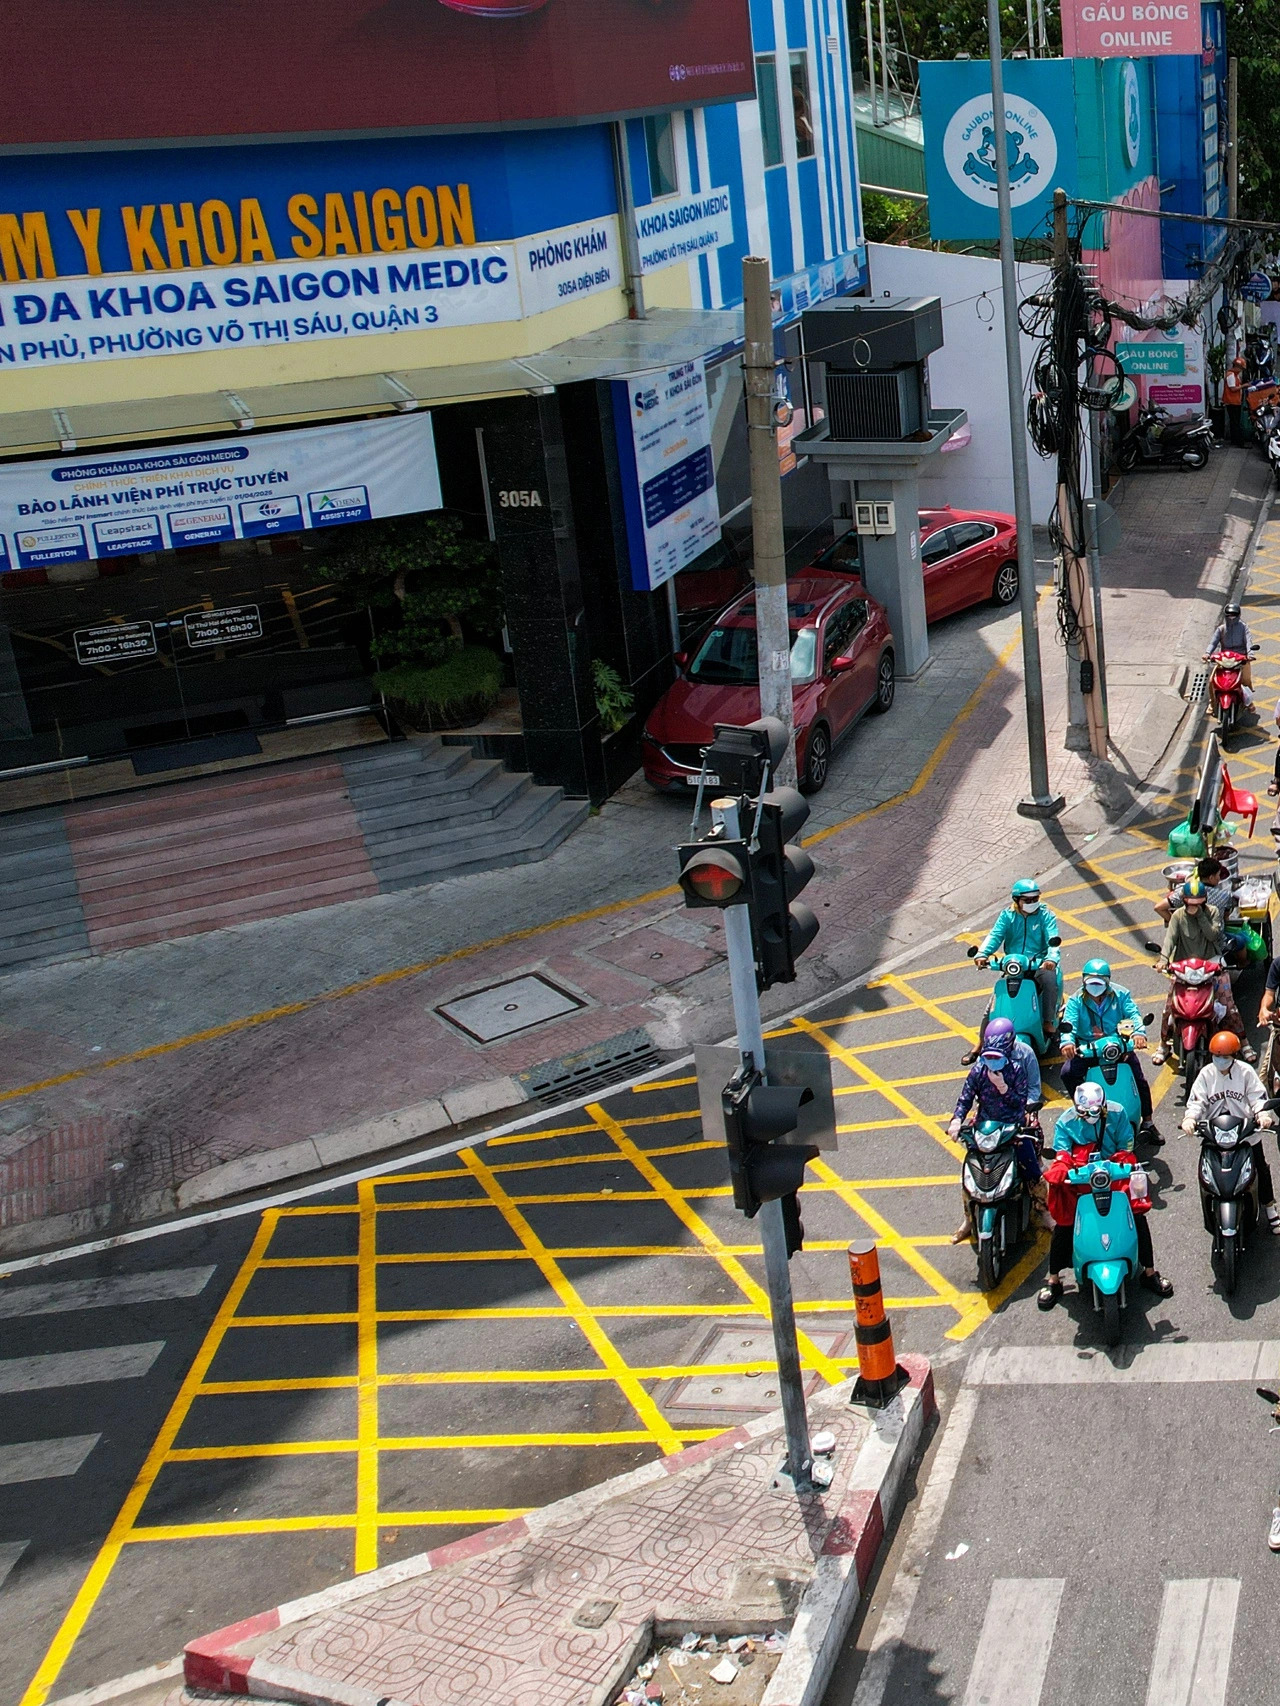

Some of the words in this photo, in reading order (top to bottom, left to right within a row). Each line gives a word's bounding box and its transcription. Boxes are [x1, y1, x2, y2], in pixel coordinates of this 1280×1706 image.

[1132, 2, 1189, 20] BÔNG
[1100, 31, 1173, 47] ONLINE
[640, 213, 668, 238] KHOA
[669, 203, 703, 228] SAIGON
[703, 194, 729, 217] MEDIC
[0, 212, 57, 282] M
[66, 208, 103, 276] Y
[121, 198, 277, 273] KHOA
[287, 183, 476, 259] SAIGON
[529, 242, 573, 272] PHÒNG
[574, 228, 608, 257] KHÁM
[14, 291, 82, 325] ĐA
[88, 281, 217, 319] KHOA
[223, 266, 380, 308] SAIGON
[387, 256, 509, 293] MEDIC
[558, 281, 577, 297] 305A
[21, 333, 86, 361] PHỦ,
[89, 326, 203, 355] PHƯỜNG
[207, 320, 245, 344] VÕ
[249, 319, 290, 342] THỊ
[293, 311, 349, 336] SÁU,
[352, 304, 419, 331] QUẬN
[424, 305, 439, 323] 3
[1131, 362, 1169, 370] ONLINE
[61, 468, 97, 479] PHÒNG
[98, 464, 128, 475] KHÁM
[129, 462, 143, 471] ĐA
[144, 459, 172, 470] KHOA
[173, 457, 188, 466] SÀI
[189, 454, 211, 464] GÒN
[211, 451, 241, 461] MEDIC
[60, 493, 109, 511] LÃNH
[111, 487, 153, 505] VIỆN
[155, 481, 185, 499] PHÍ
[187, 477, 232, 494] TRỰC
[235, 469, 289, 487] TUYẾN
[499, 490, 542, 507] 305A
[186, 513, 227, 525] GENERALI
[320, 511, 345, 521] ASSIST
[101, 522, 153, 536] Leapstack
[184, 530, 222, 540] GENERALI
[107, 540, 152, 551] LEAPSTACK
[31, 550, 77, 561] FULLERTON
[195, 628, 219, 638] 7h00
[225, 623, 253, 633] 16h30
[86, 645, 111, 654] 7h00
[118, 639, 147, 649] 16h30
